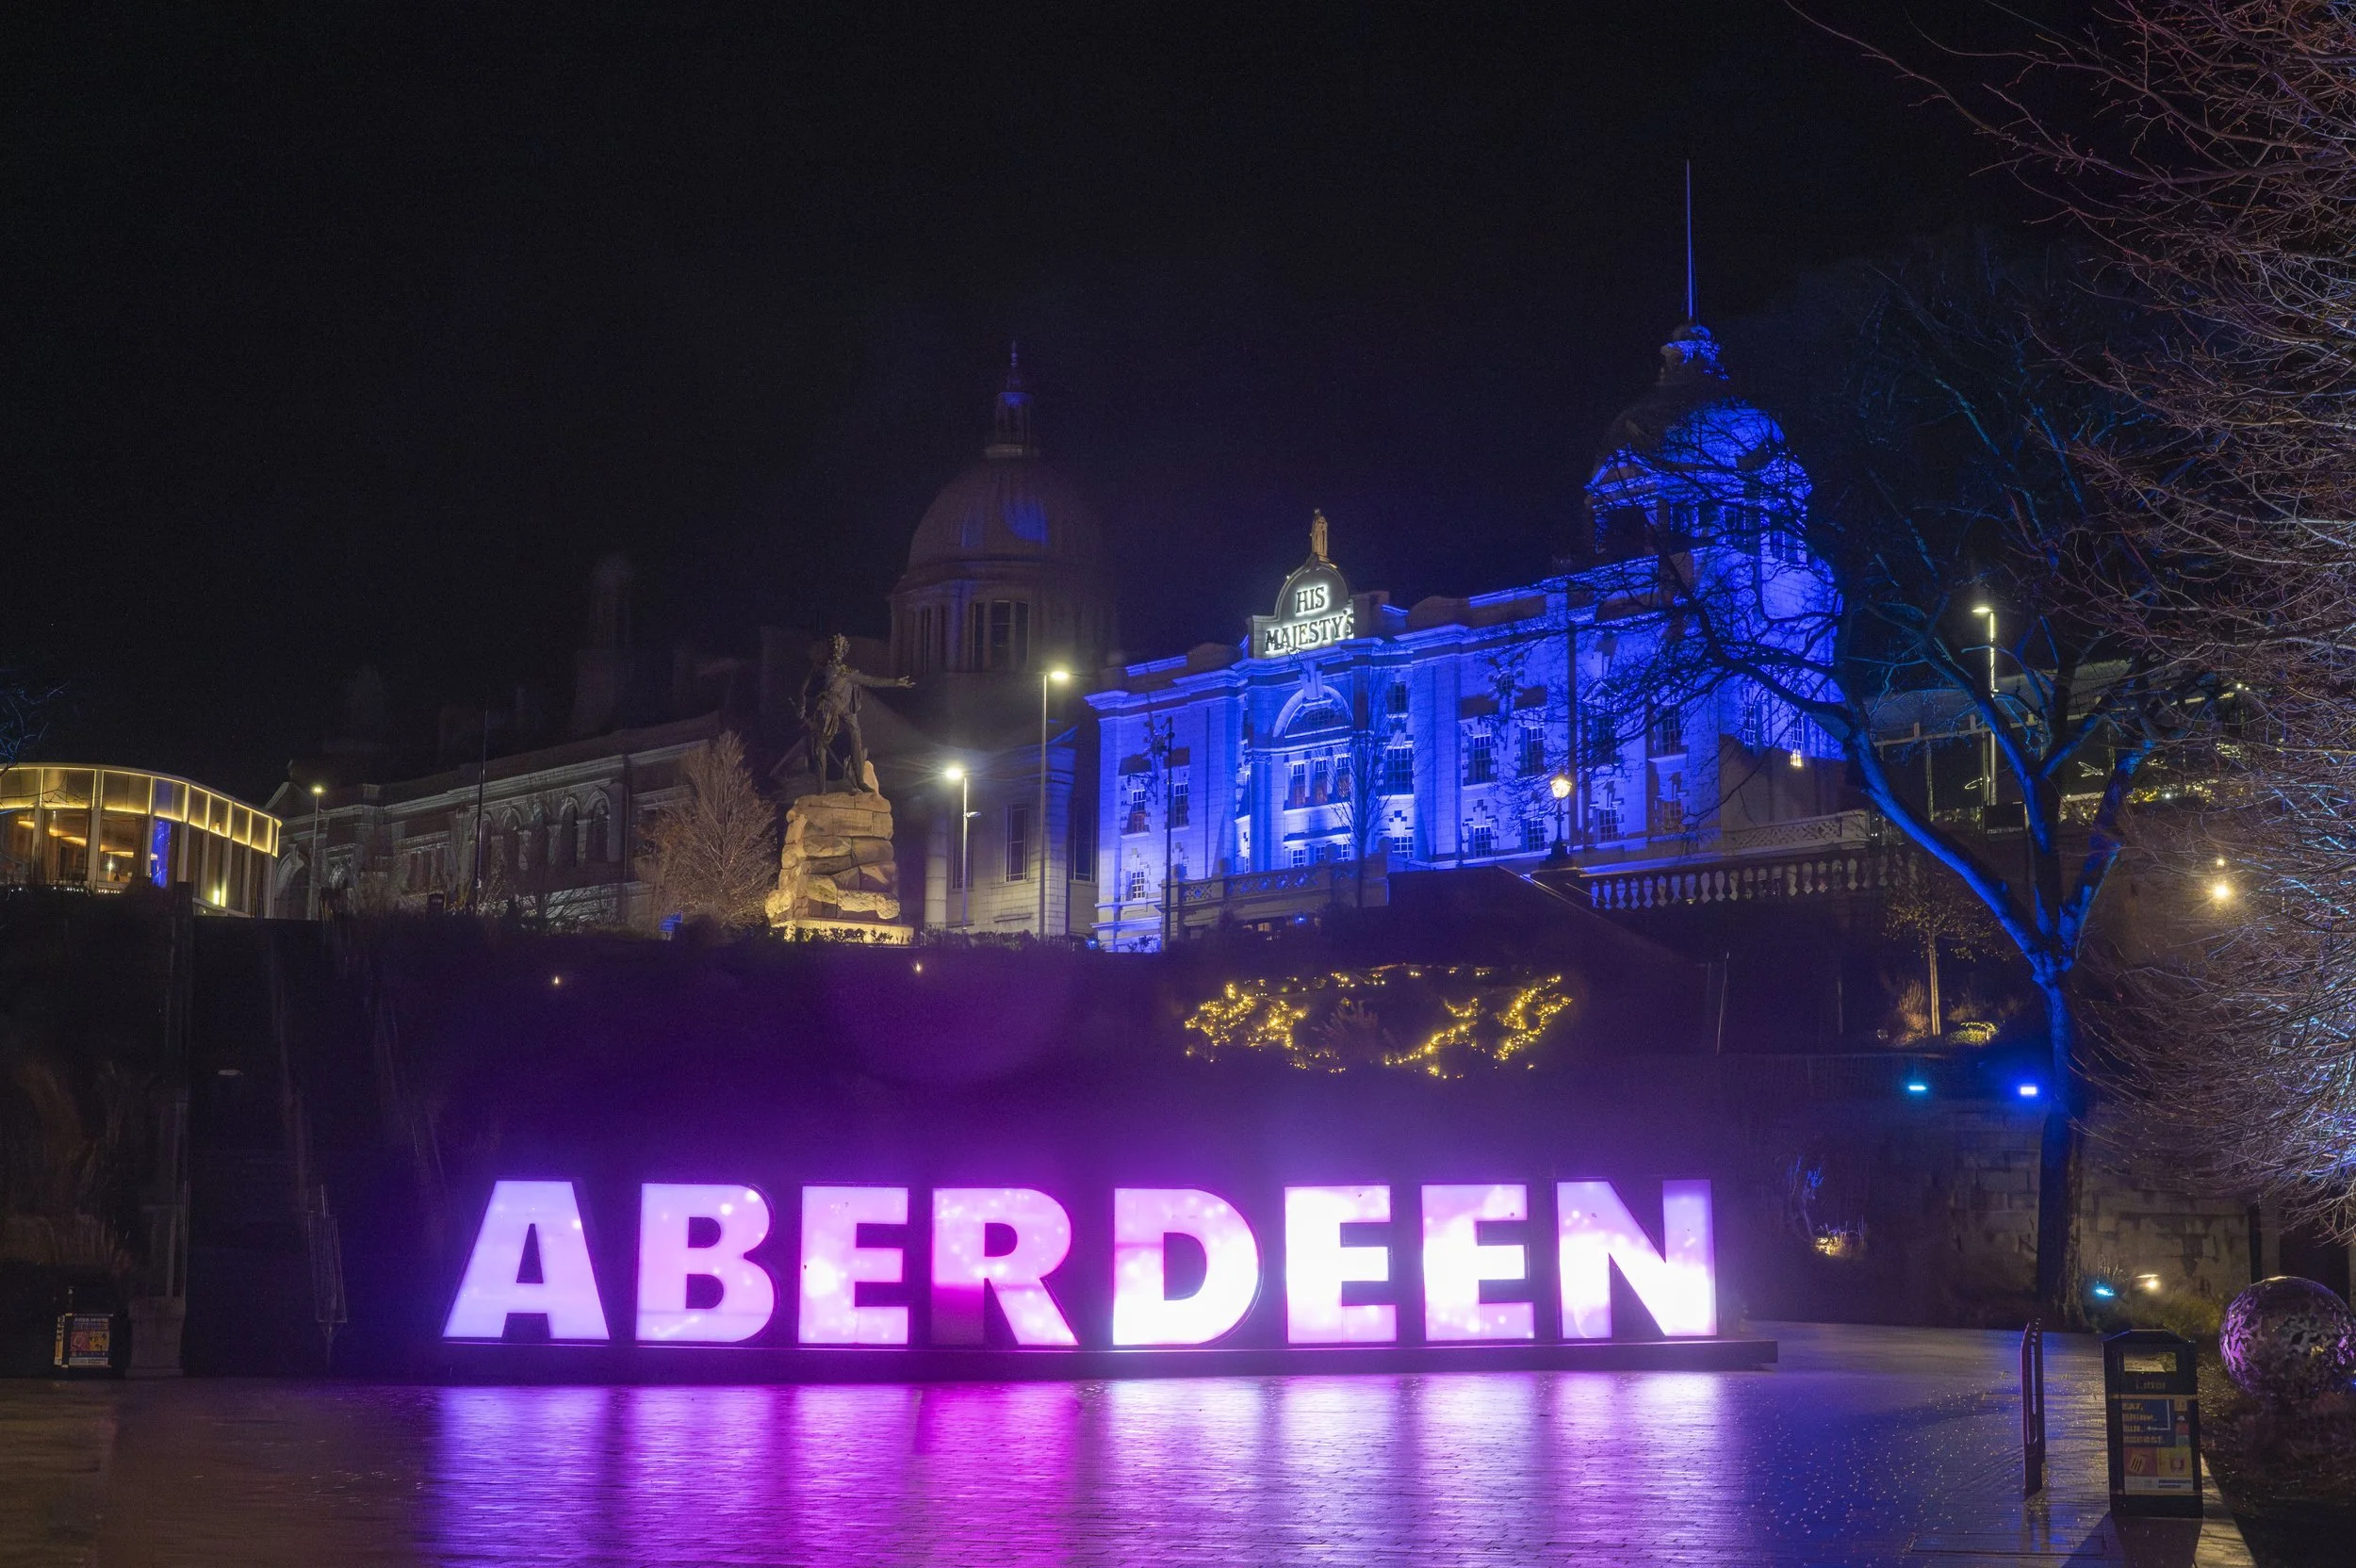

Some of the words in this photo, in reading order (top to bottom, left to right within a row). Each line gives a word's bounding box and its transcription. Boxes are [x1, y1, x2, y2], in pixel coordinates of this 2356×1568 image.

[1296, 586, 1325, 613] HIS
[1265, 610, 1353, 652] MAJESTY'S
[442, 1179, 1717, 1348] ABERDEEN
